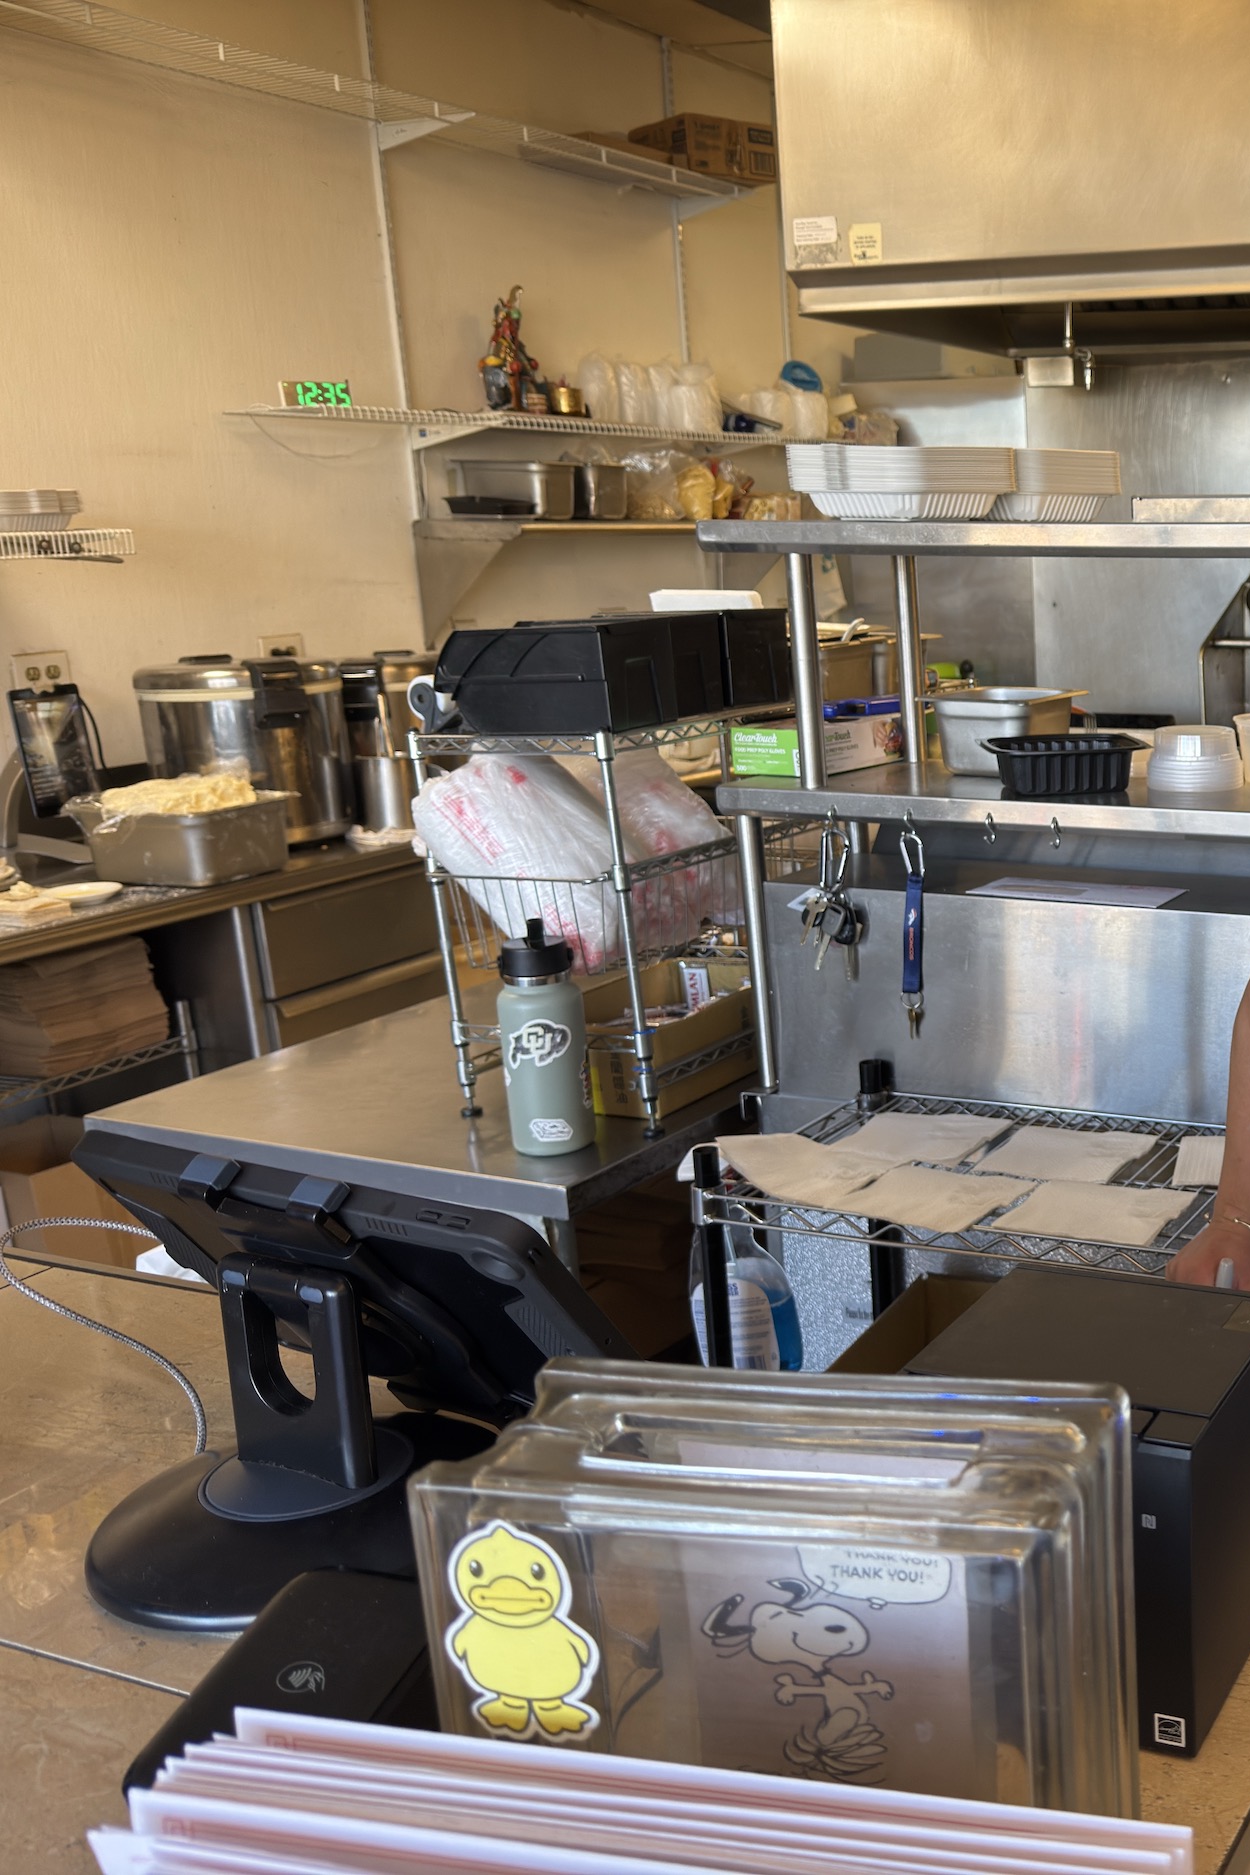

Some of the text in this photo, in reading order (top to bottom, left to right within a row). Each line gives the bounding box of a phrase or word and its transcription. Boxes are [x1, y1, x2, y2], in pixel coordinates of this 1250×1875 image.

[296, 381, 351, 408] 12:35
[734, 731, 778, 743] ClearTouch
[523, 1026, 553, 1057] CU
[830, 1564, 924, 1585] THANK YOU!
